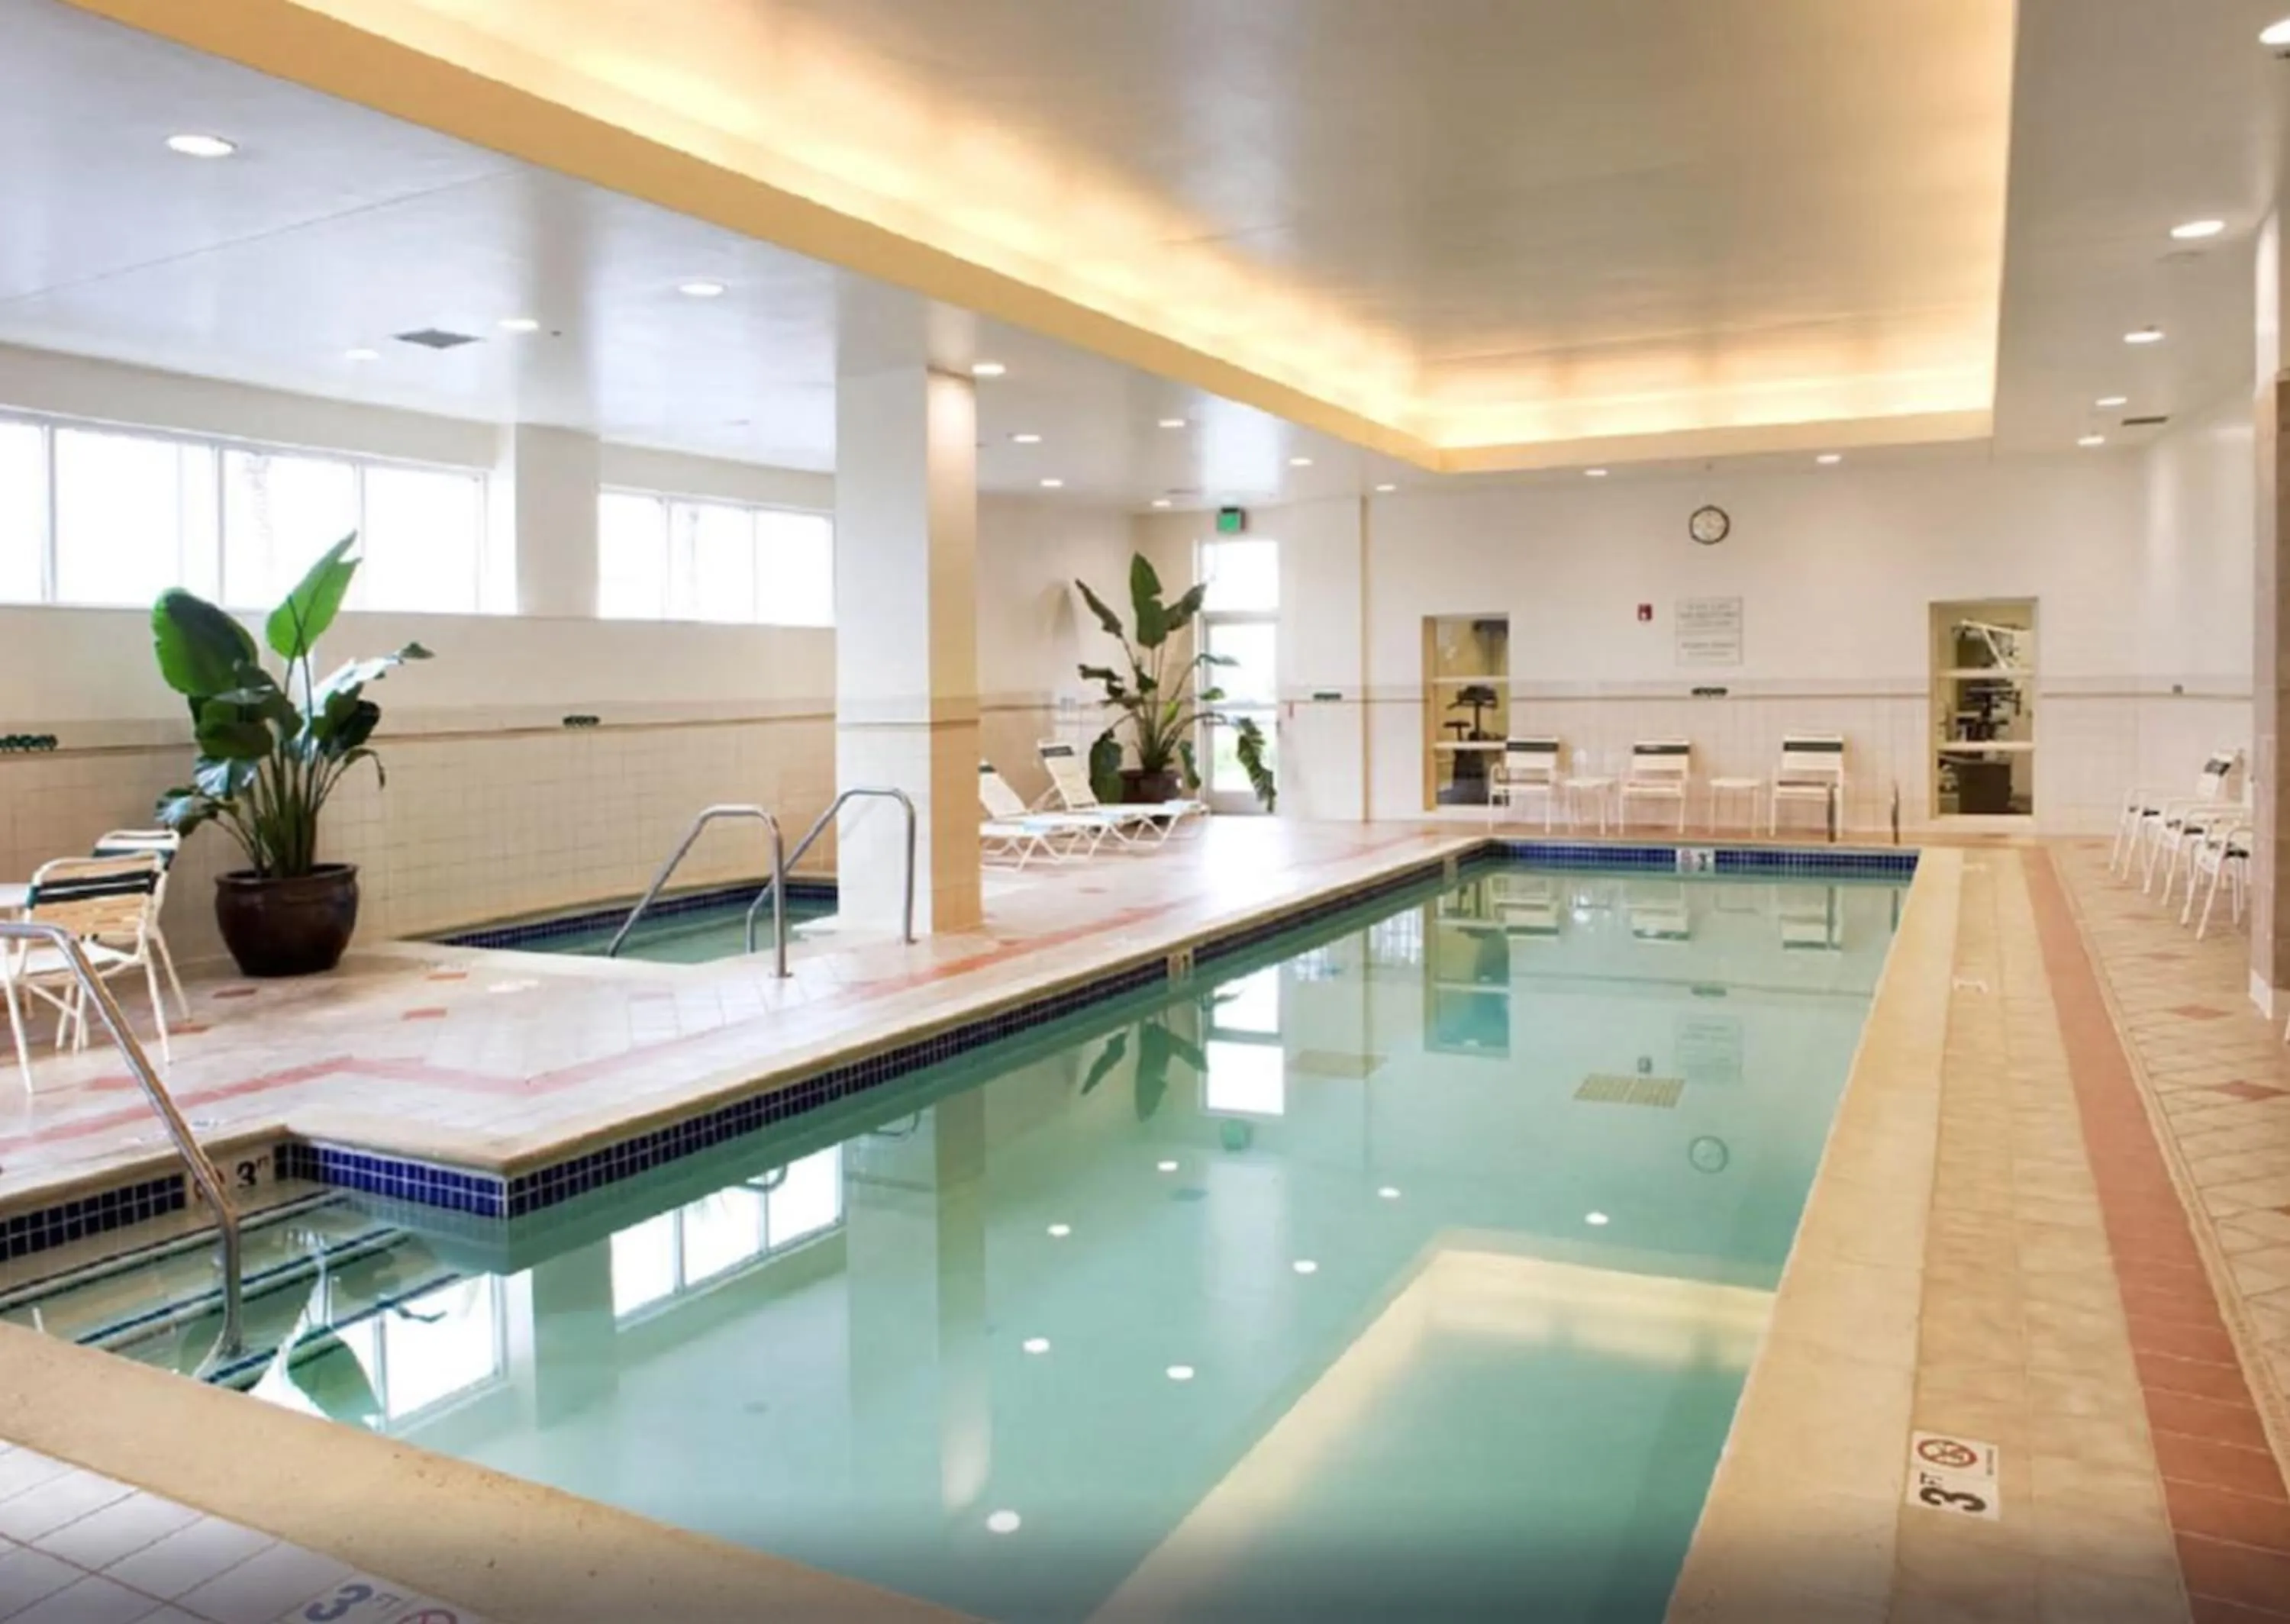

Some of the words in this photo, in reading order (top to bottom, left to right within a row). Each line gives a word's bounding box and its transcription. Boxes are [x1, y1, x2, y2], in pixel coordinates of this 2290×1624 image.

[237, 1160, 257, 1187] 3
[1919, 1487, 1986, 1512] 3
[304, 1584, 374, 1622] 3
